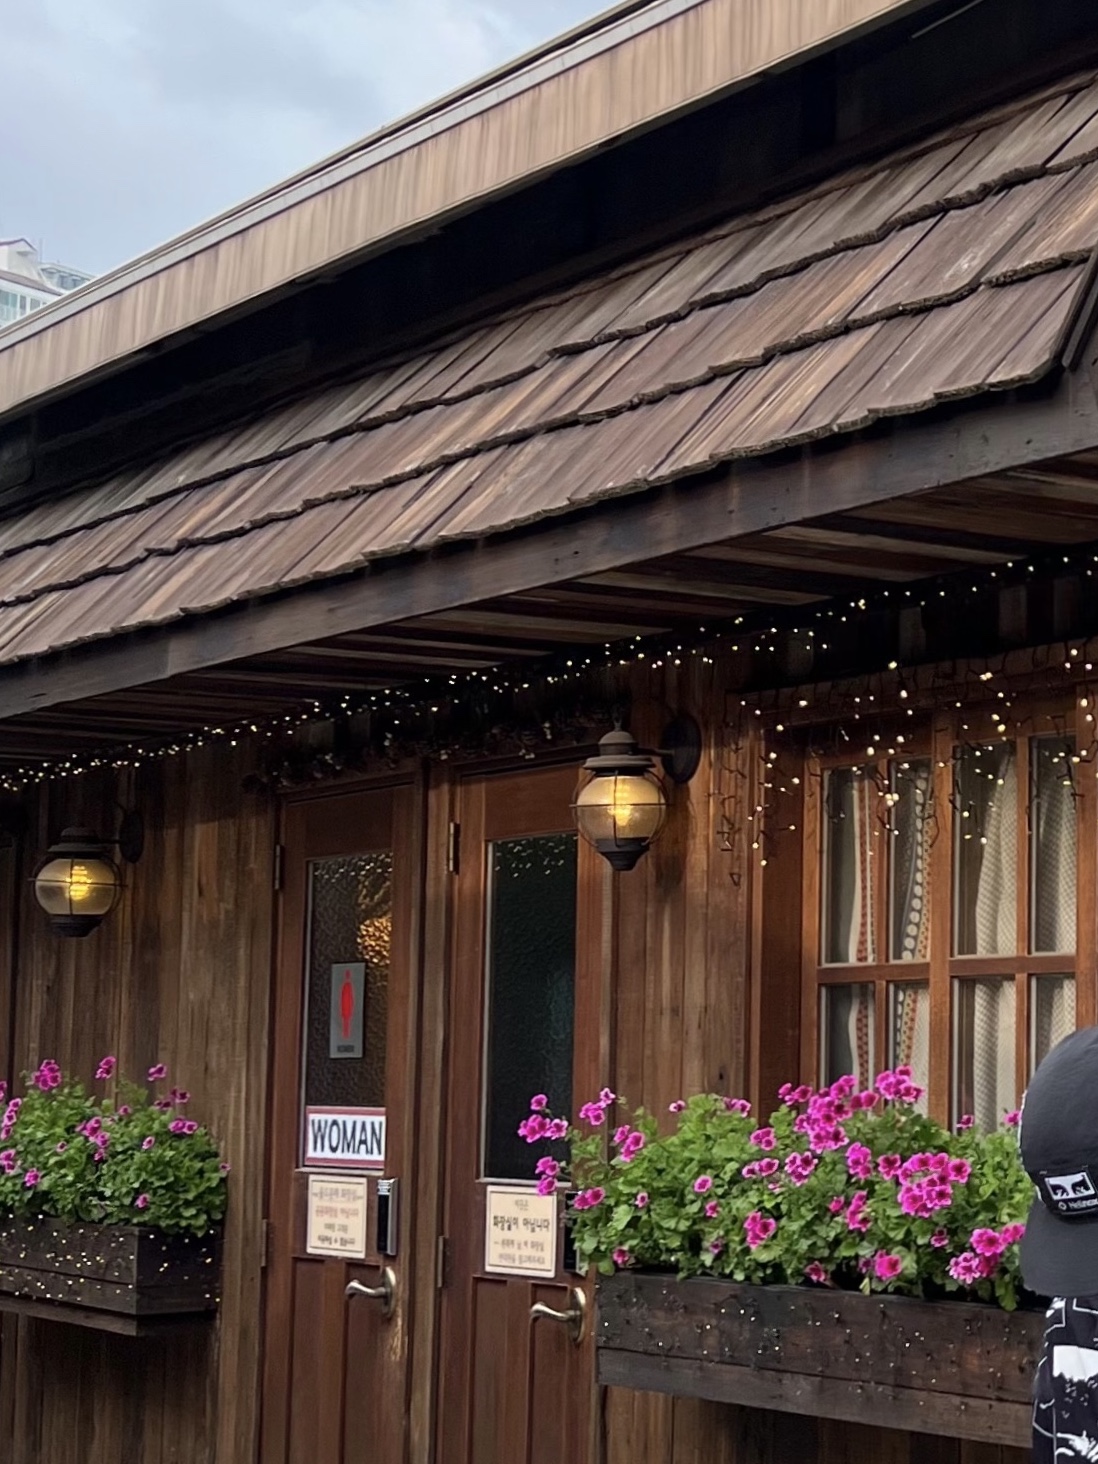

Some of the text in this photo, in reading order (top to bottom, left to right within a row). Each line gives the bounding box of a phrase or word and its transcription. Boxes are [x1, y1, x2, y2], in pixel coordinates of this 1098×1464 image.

[311, 1119, 383, 1156] WOMAN
[493, 1215, 550, 1233] 화장실이 아닙니다
